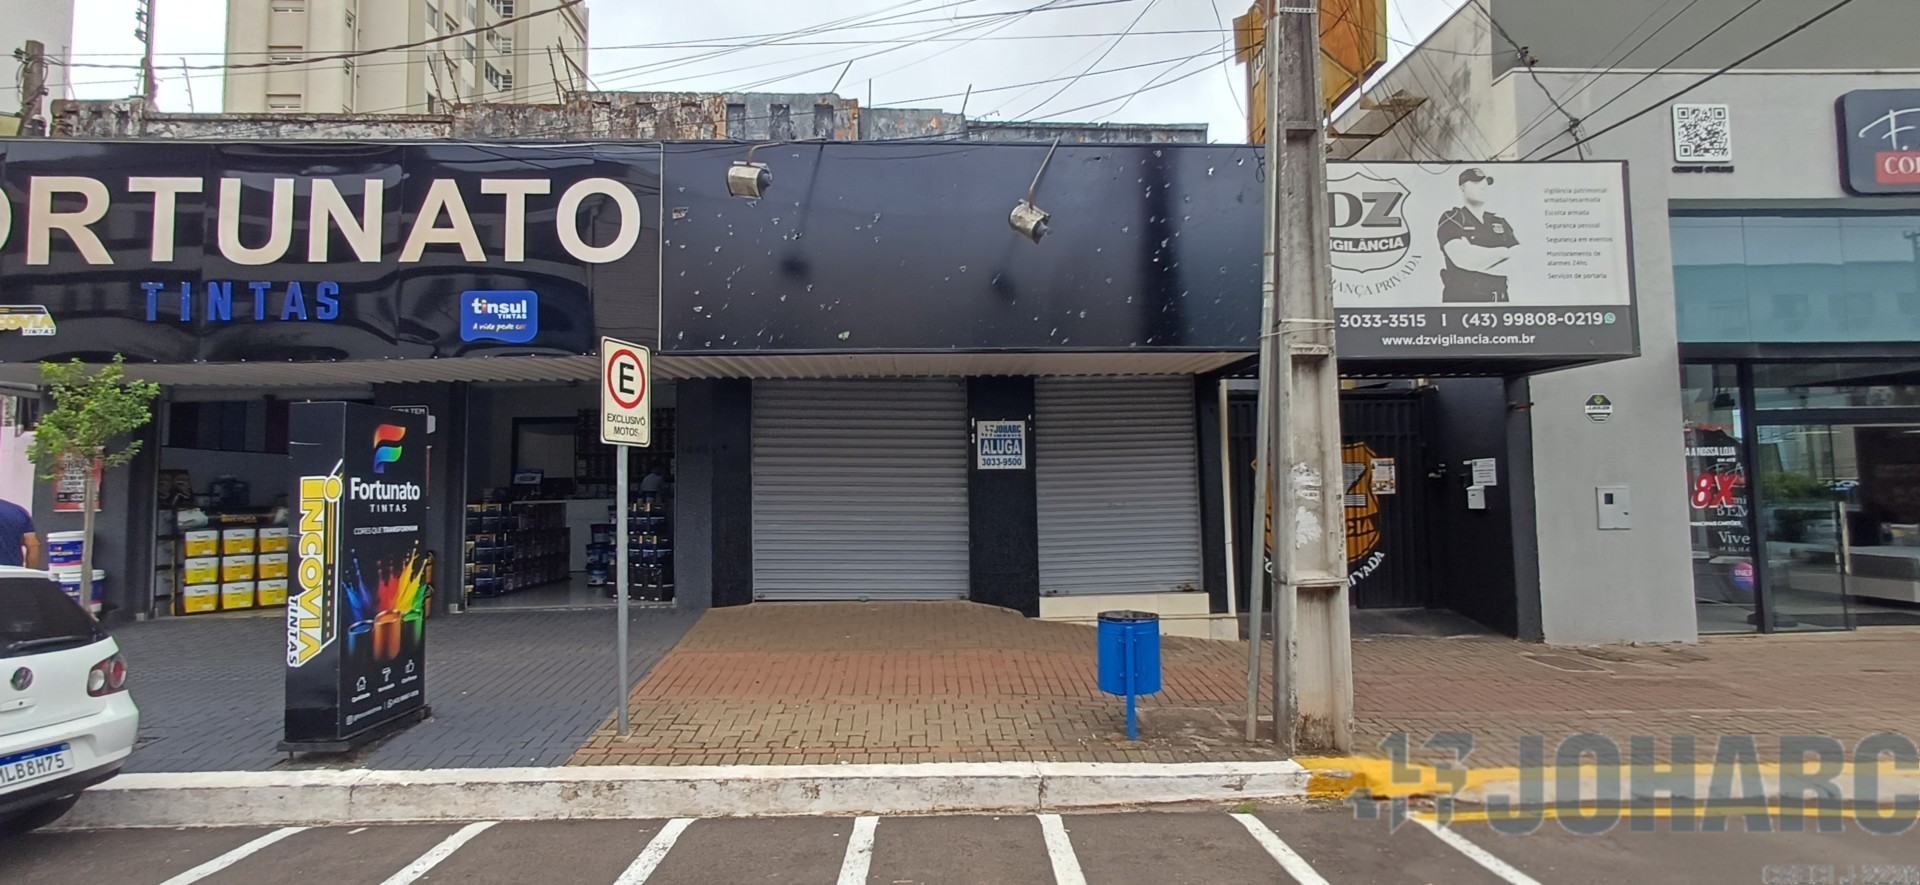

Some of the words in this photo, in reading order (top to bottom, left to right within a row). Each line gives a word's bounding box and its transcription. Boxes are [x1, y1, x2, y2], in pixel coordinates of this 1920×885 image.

[1327, 191, 1403, 228] DZ
[1546, 236, 1577, 244] Segurança
[1547, 272, 1573, 280] Serviços
[141, 281, 340, 322] TINTAS
[471, 297, 527, 314] tinsul
[1339, 313, 1427, 328] 3033-3515
[1462, 312, 1498, 329] (43)
[1502, 312, 1604, 326] 99808-0219
[1381, 333, 1536, 347] www.dzvigilancia.com.br
[619, 361, 635, 395] E
[607, 412, 646, 426] EXCLUSIVO
[613, 426, 640, 437] MOTOS
[982, 439, 1022, 455] ALUGA
[982, 458, 1022, 466] 3033-9500
[350, 477, 421, 501] Fortunato
[1691, 472, 1738, 509] 8X
[369, 503, 408, 513] TINTAS
[288, 596, 299, 665] TINTAS
